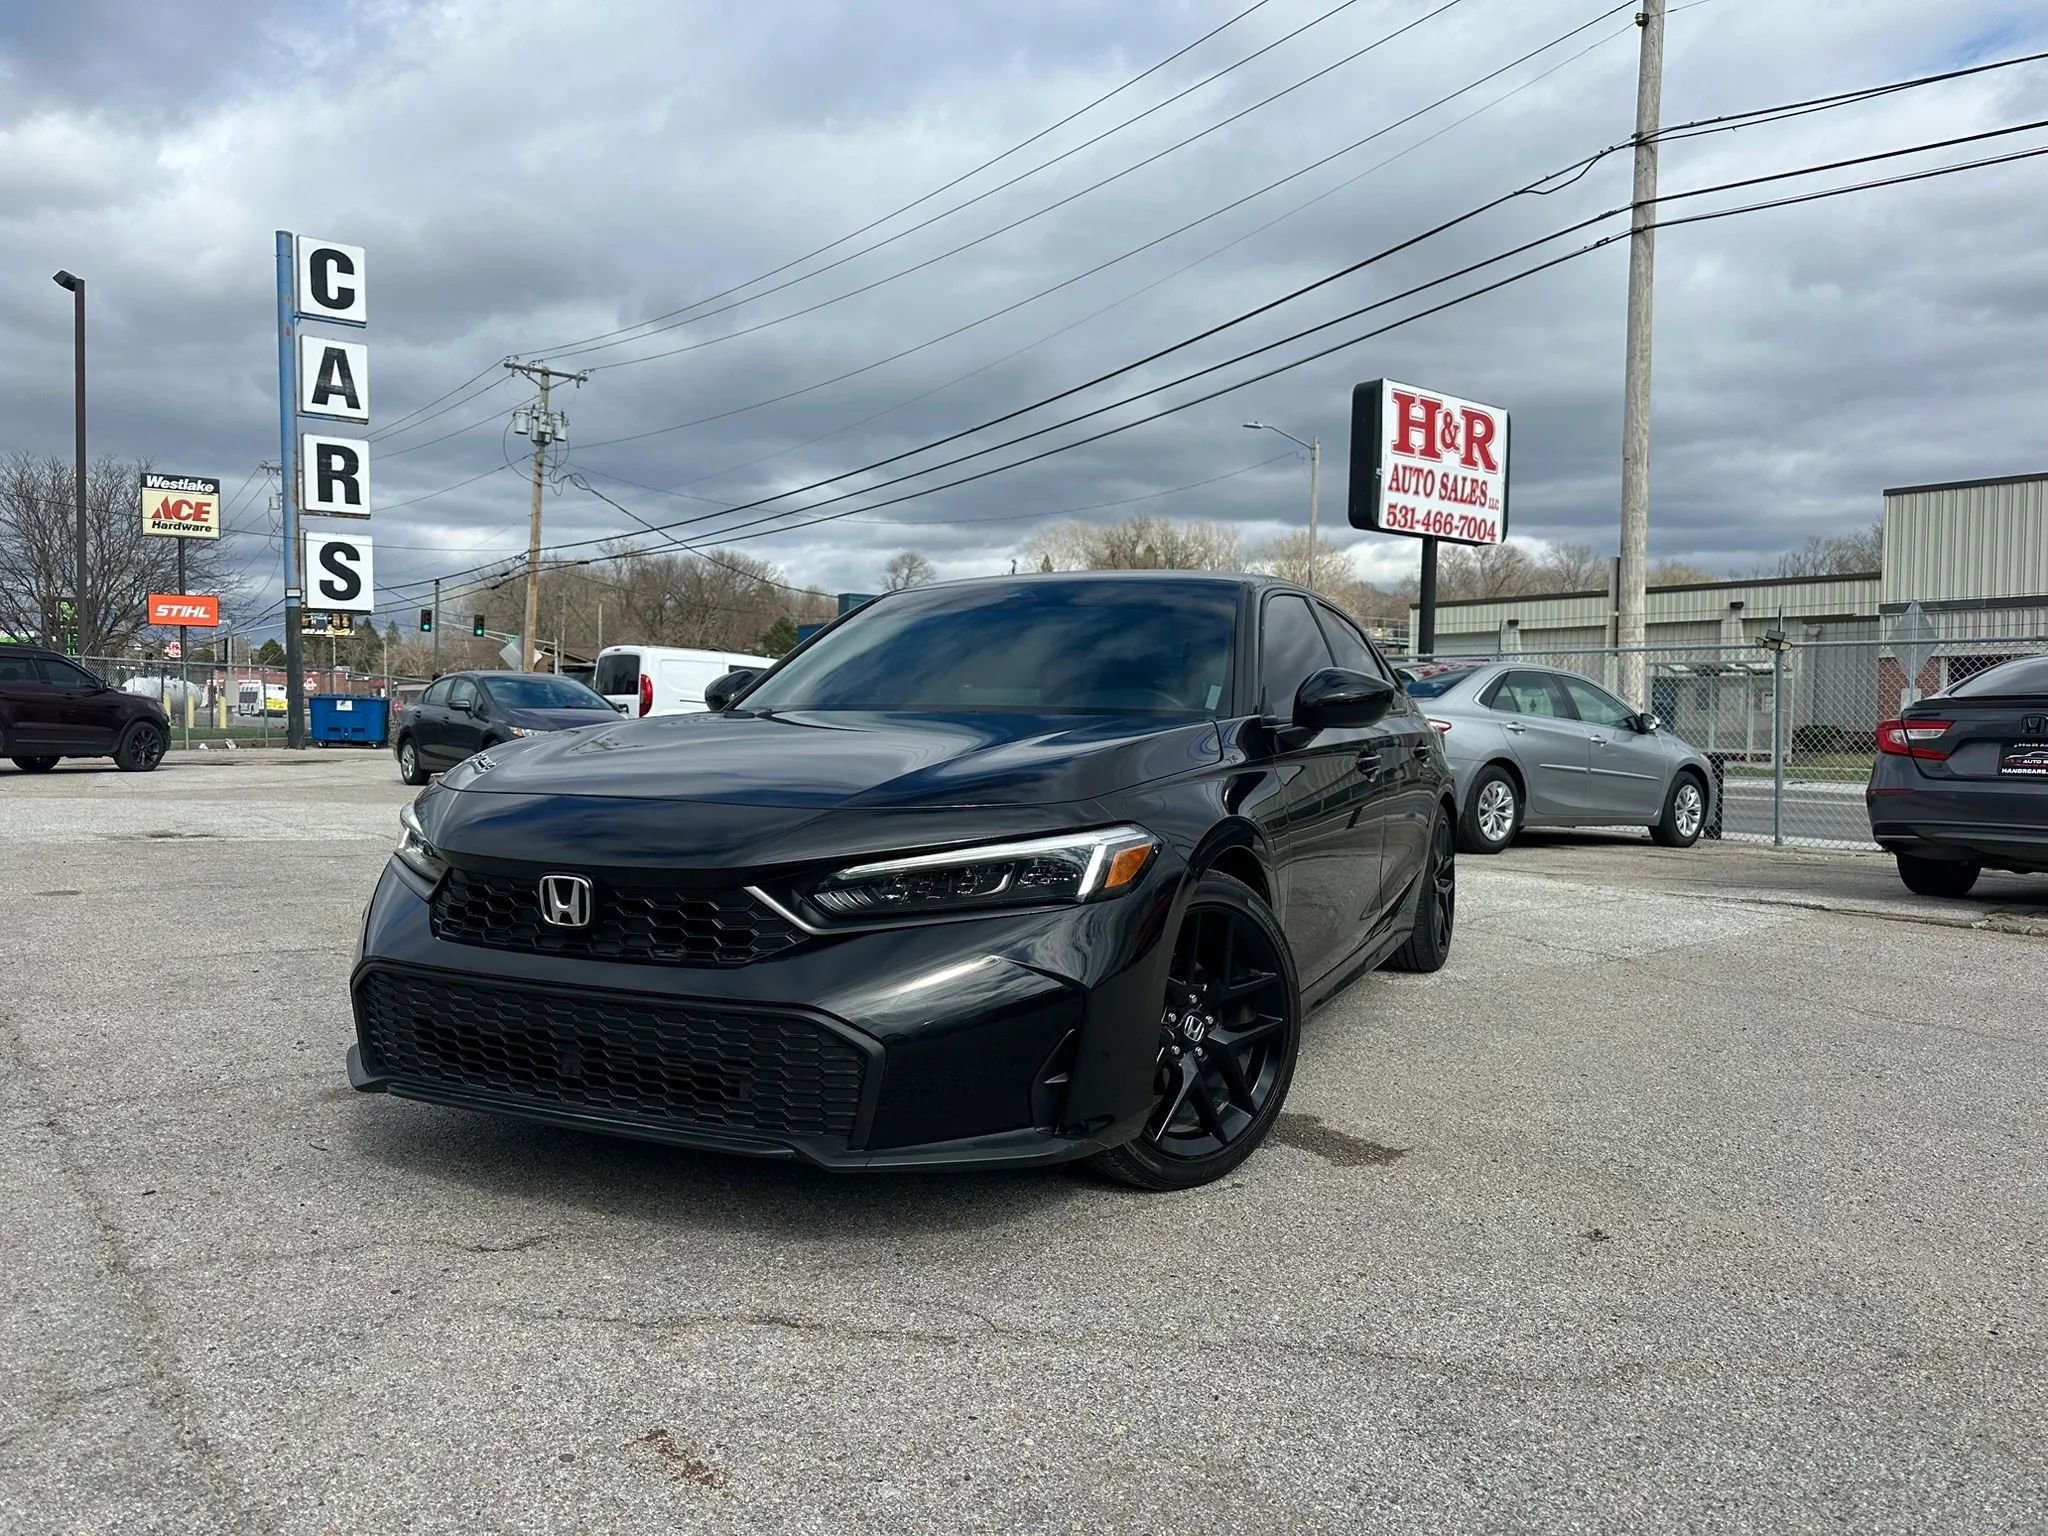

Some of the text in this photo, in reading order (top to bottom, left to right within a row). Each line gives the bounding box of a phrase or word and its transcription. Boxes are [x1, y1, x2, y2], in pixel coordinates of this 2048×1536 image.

[310, 248, 361, 601] CARS
[1391, 388, 1498, 475] H&R
[146, 474, 215, 493] Westlake
[1387, 463, 1500, 511] AUTO SALES LLC
[150, 496, 212, 522] ACE
[1386, 502, 1497, 542] 531-466-7004
[151, 520, 212, 533] Hardware
[154, 605, 210, 619] STIHL
